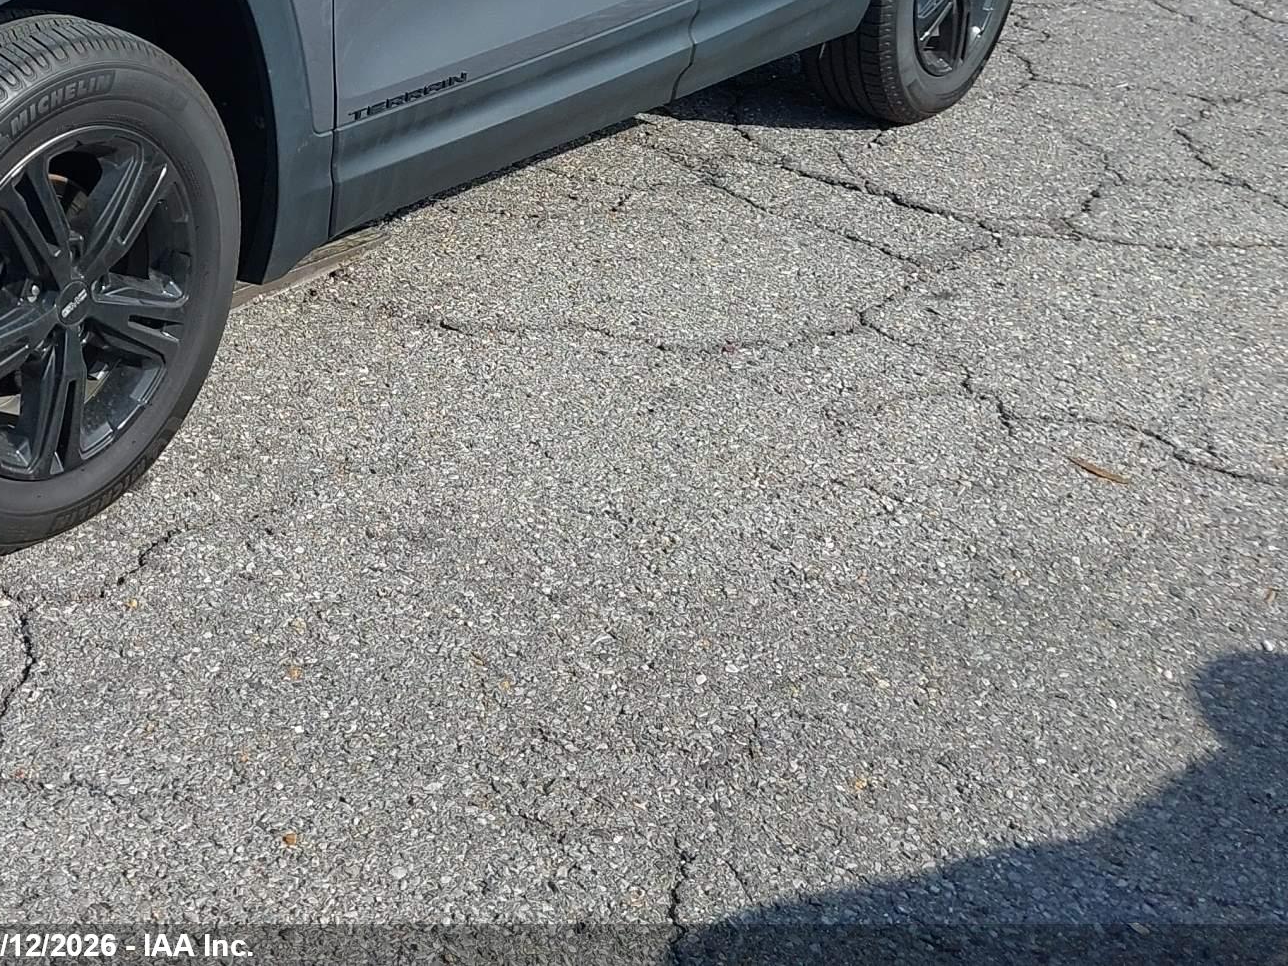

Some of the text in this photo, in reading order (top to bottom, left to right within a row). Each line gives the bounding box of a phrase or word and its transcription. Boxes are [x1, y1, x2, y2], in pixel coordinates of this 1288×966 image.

[10, 74, 112, 135] MICHELIN
[349, 72, 469, 121] TERRAIN
[62, 289, 87, 318] GMC
